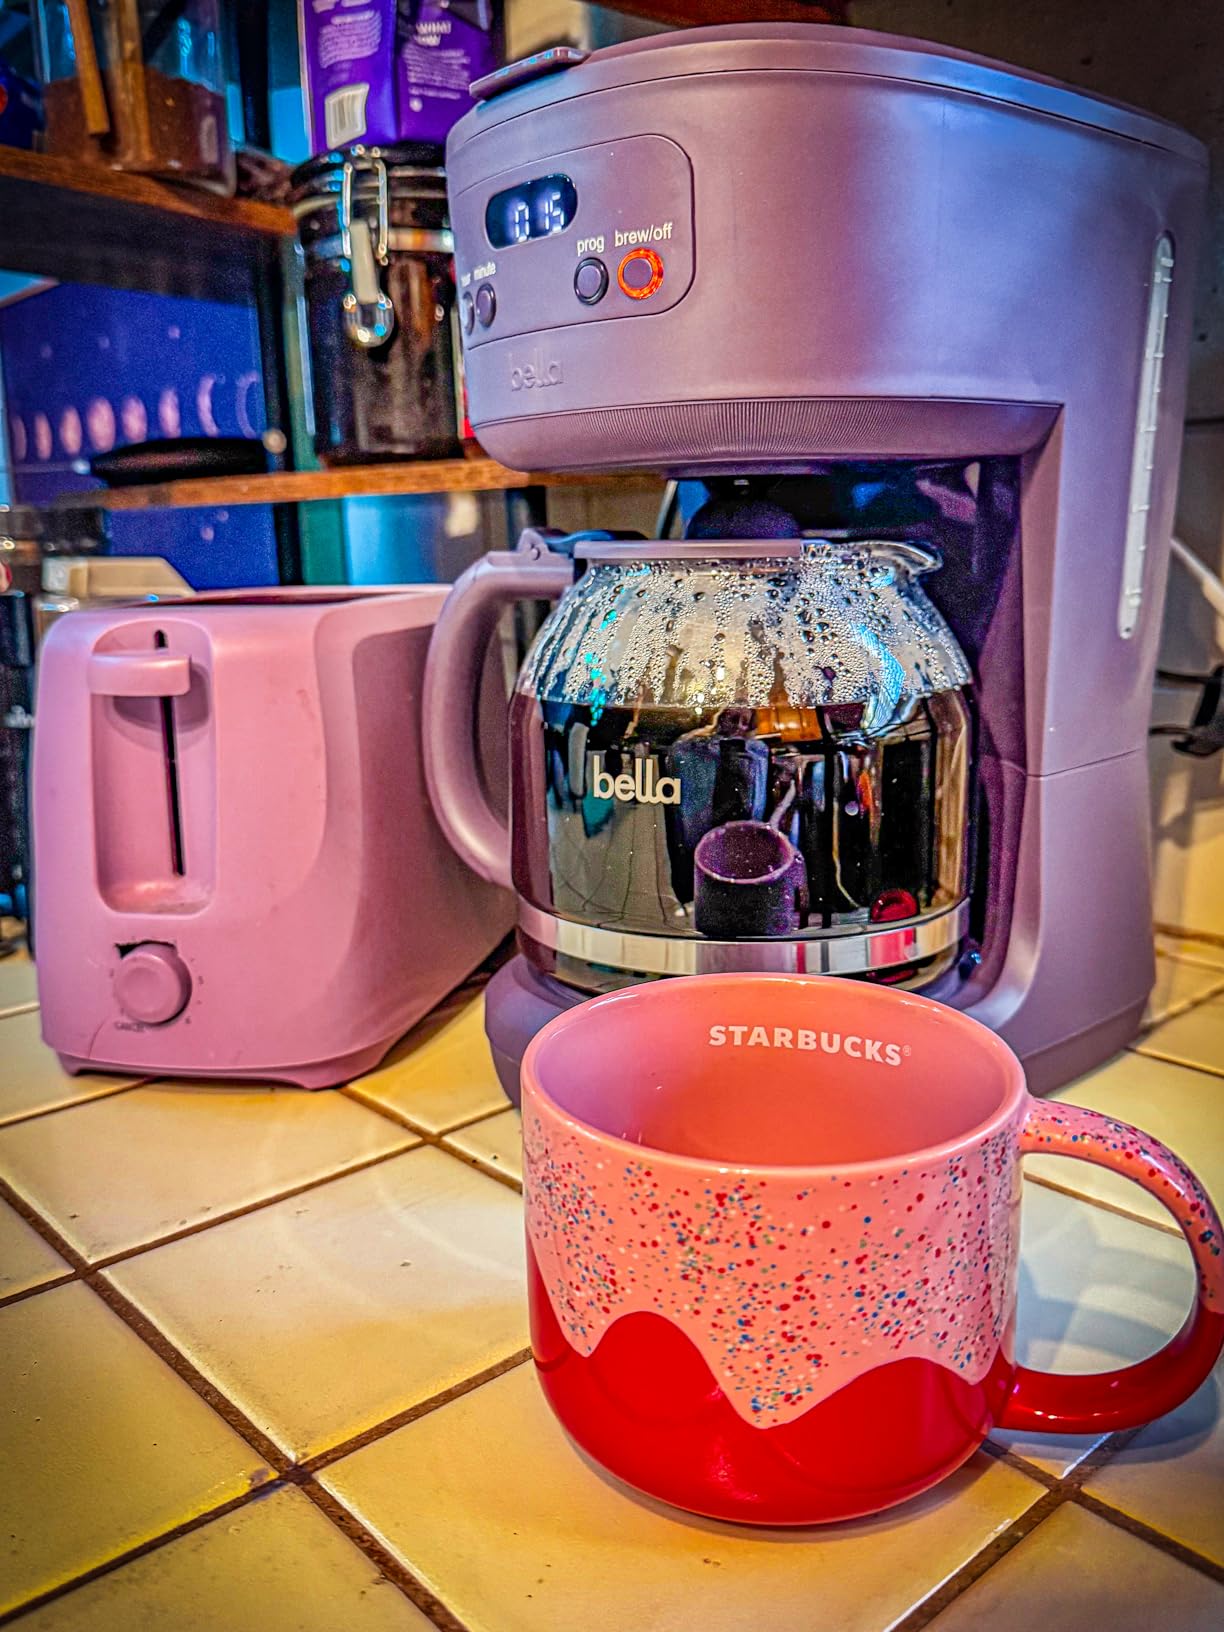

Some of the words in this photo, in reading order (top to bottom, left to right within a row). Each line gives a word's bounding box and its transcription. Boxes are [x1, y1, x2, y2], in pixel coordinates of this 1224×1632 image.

[576, 235, 605, 257] prog
[614, 221, 673, 247] brew/off
[508, 349, 565, 392] bella
[593, 754, 682, 805] bella
